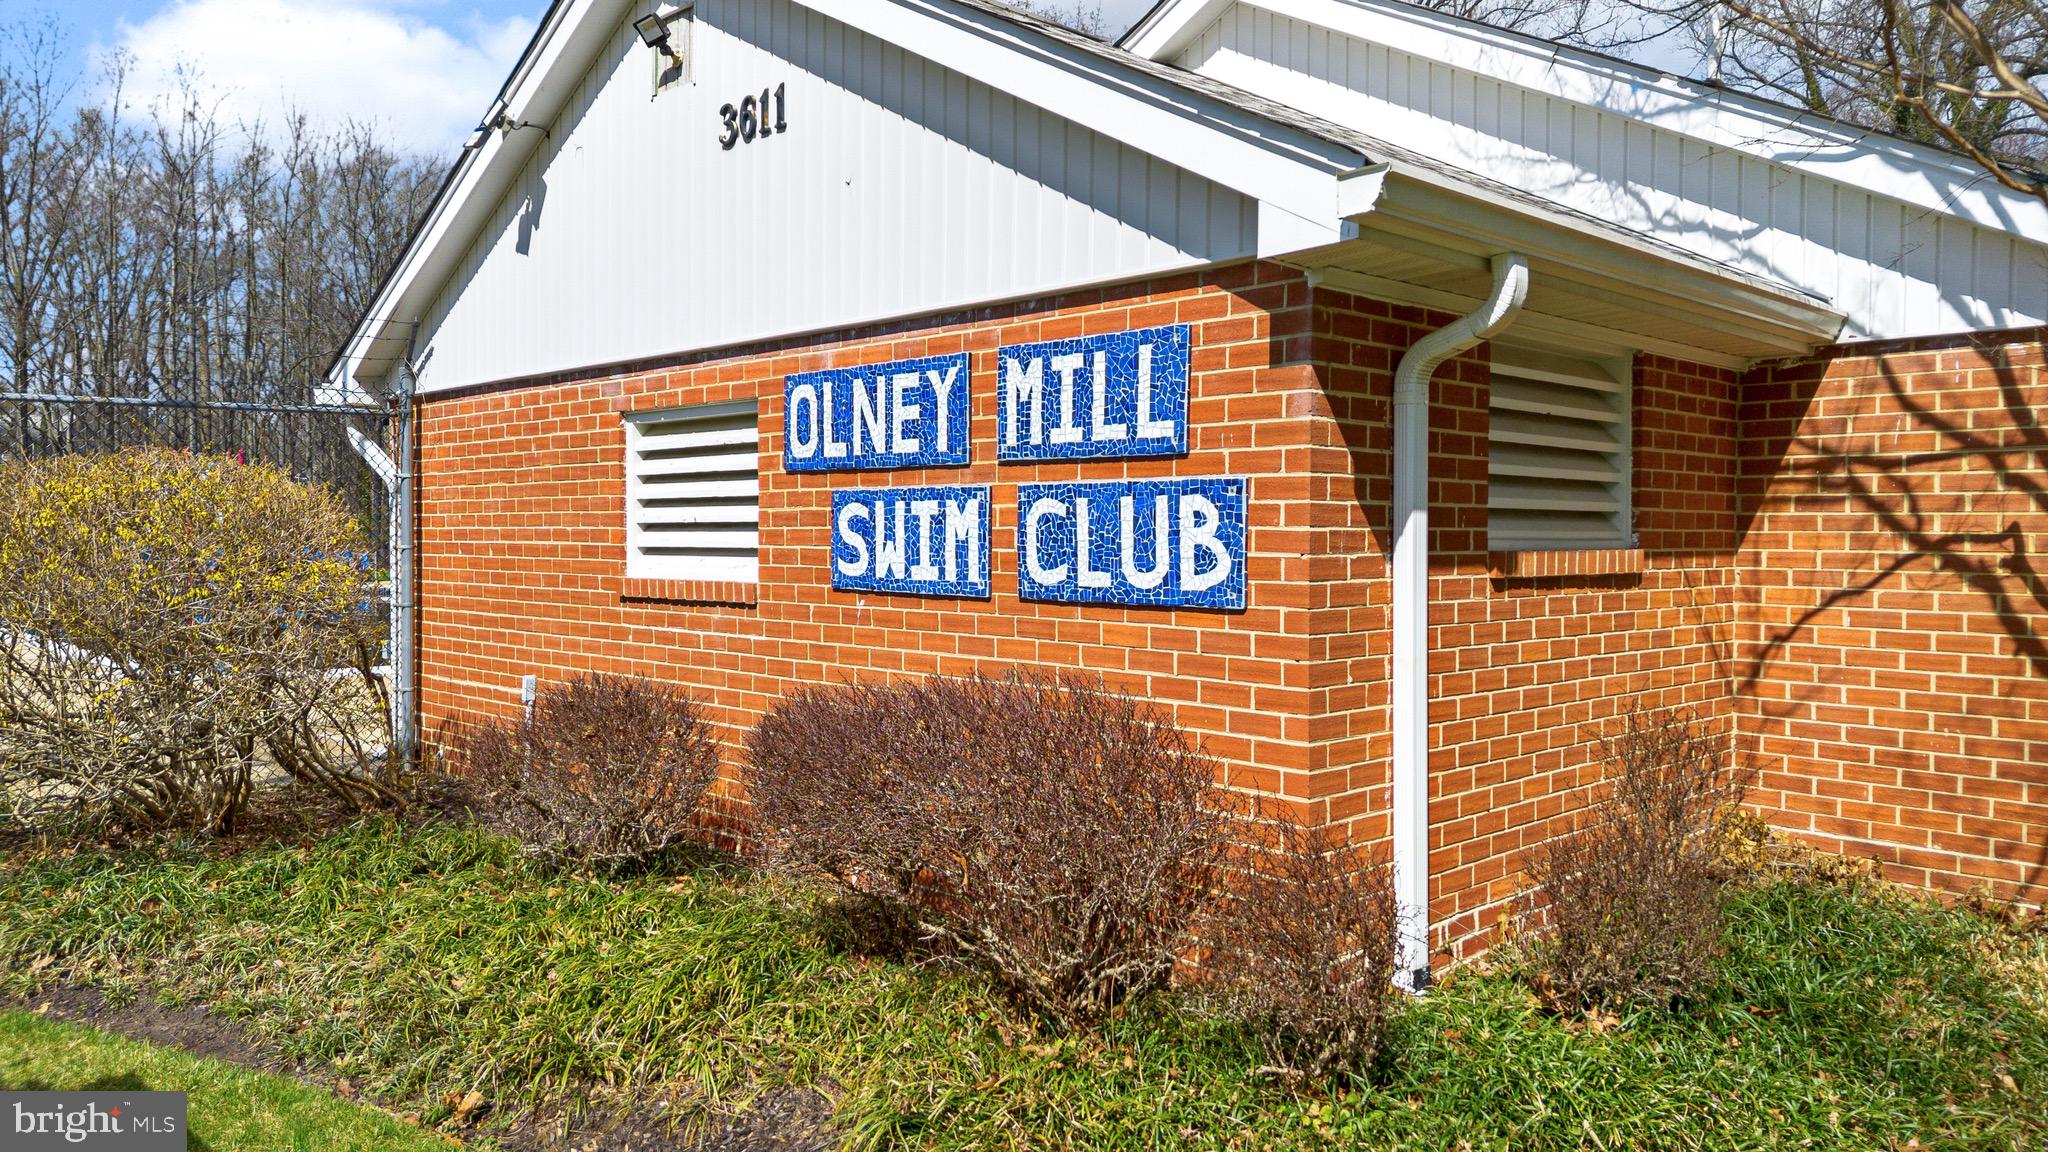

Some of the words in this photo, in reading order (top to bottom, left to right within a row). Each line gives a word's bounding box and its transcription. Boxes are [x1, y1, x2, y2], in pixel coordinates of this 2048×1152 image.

[719, 82, 787, 151] 3611
[789, 365, 960, 459] OLNEY
[1004, 343, 1174, 447] MILL
[836, 498, 979, 584] SWIM
[1022, 493, 1233, 592] CLUB
